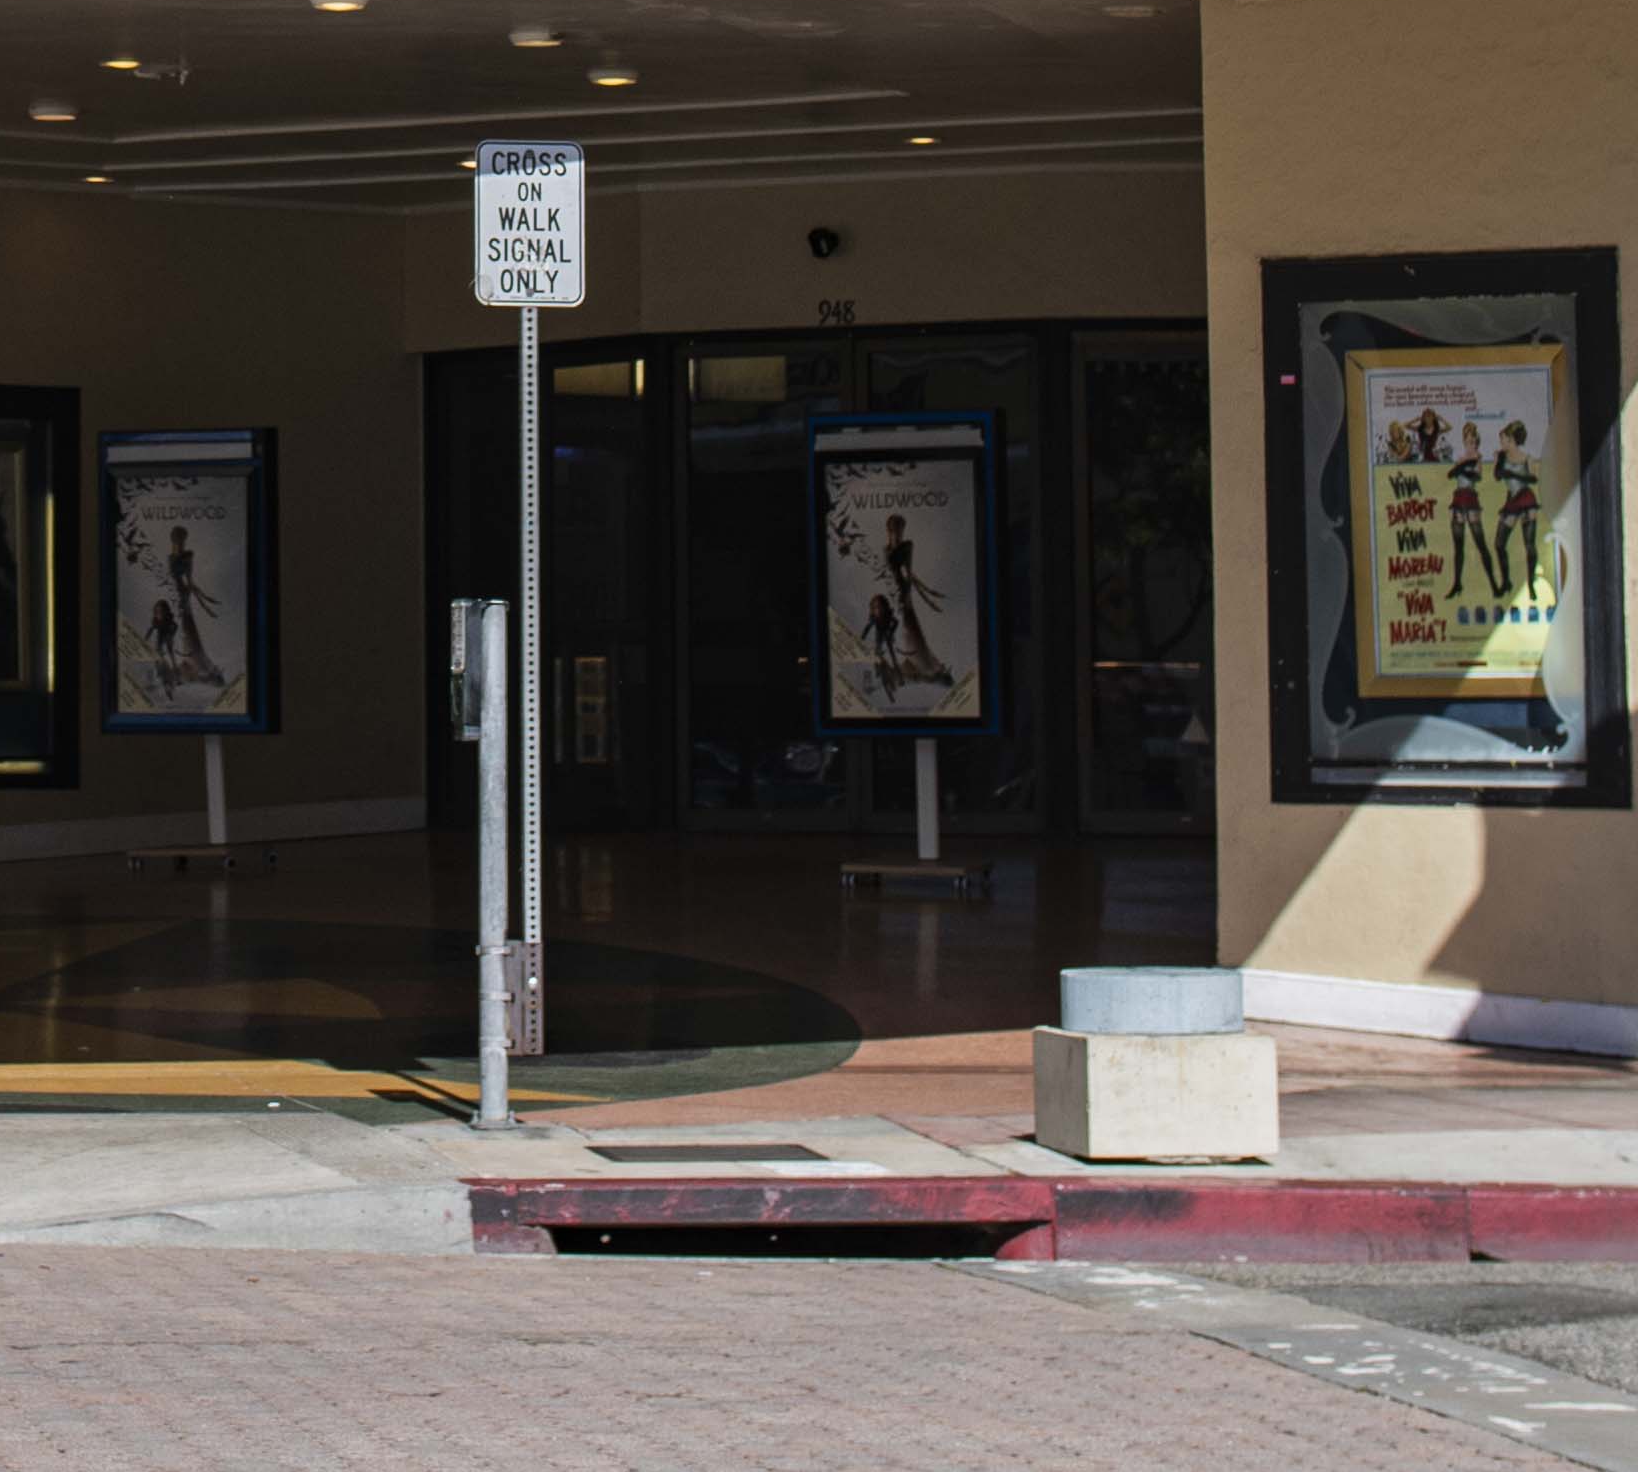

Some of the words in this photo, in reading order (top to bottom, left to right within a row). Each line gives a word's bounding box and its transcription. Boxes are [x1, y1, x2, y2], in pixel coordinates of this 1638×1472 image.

[492, 150, 567, 176] CROSS
[517, 182, 542, 202] ON
[499, 208, 561, 231] WALK
[488, 237, 572, 263] SIGNAL
[500, 269, 559, 294] ONLY
[818, 299, 855, 324] 948
[852, 490, 949, 510] WILDWOOD
[141, 506, 225, 523] WILDWOOD
[1388, 553, 1444, 582] MOREAU
